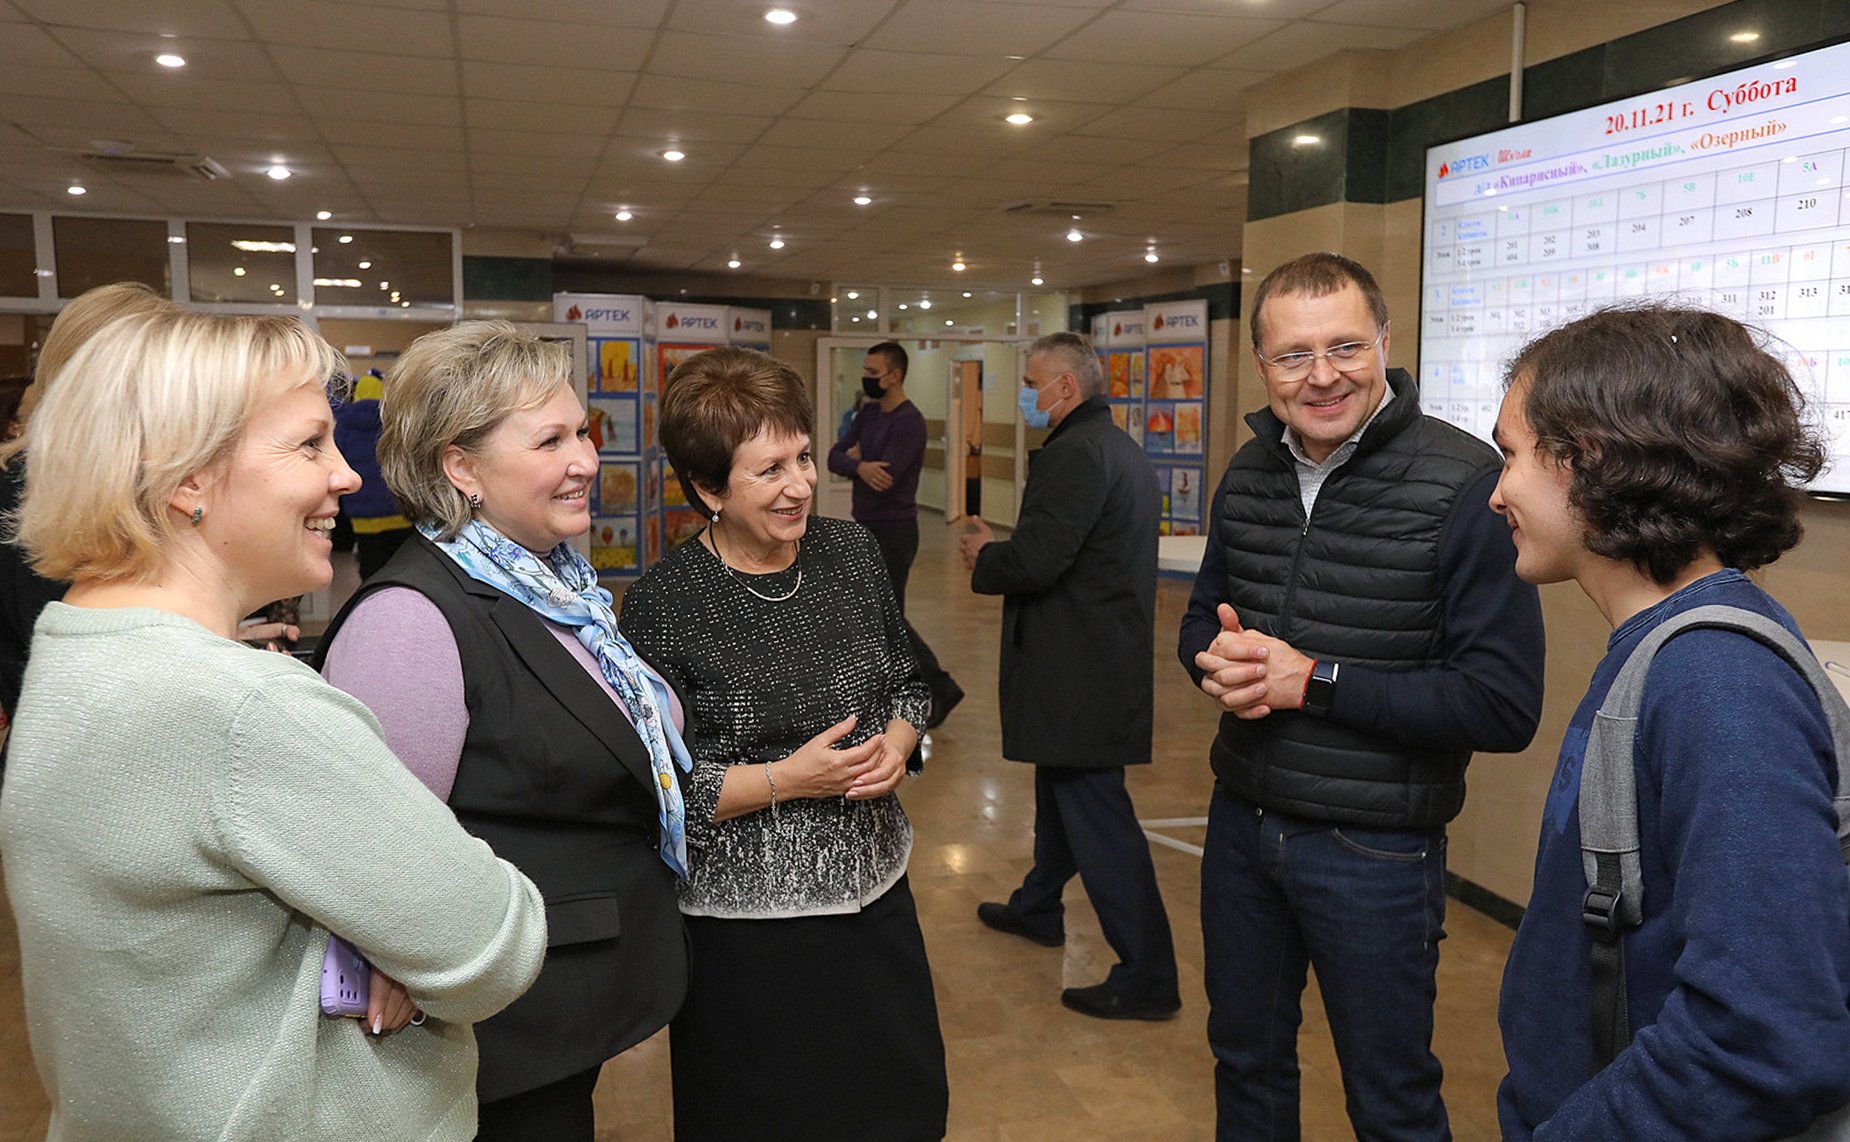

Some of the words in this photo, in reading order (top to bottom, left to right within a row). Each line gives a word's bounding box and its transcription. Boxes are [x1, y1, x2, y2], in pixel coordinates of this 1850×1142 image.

[1605, 100, 1674, 135] 20.11.21
[1707, 76, 1798, 113] Суббота
[1690, 120, 1788, 151] «Озерный»
[1797, 198, 1817, 210] 210
[1735, 207, 1753, 219] 208
[1758, 290, 1776, 302] 312
[1799, 287, 1818, 299] 313
[585, 309, 630, 322] АРТЕК
[1167, 315, 1199, 328] АРТЕК
[681, 317, 718, 329] АРТЕК
